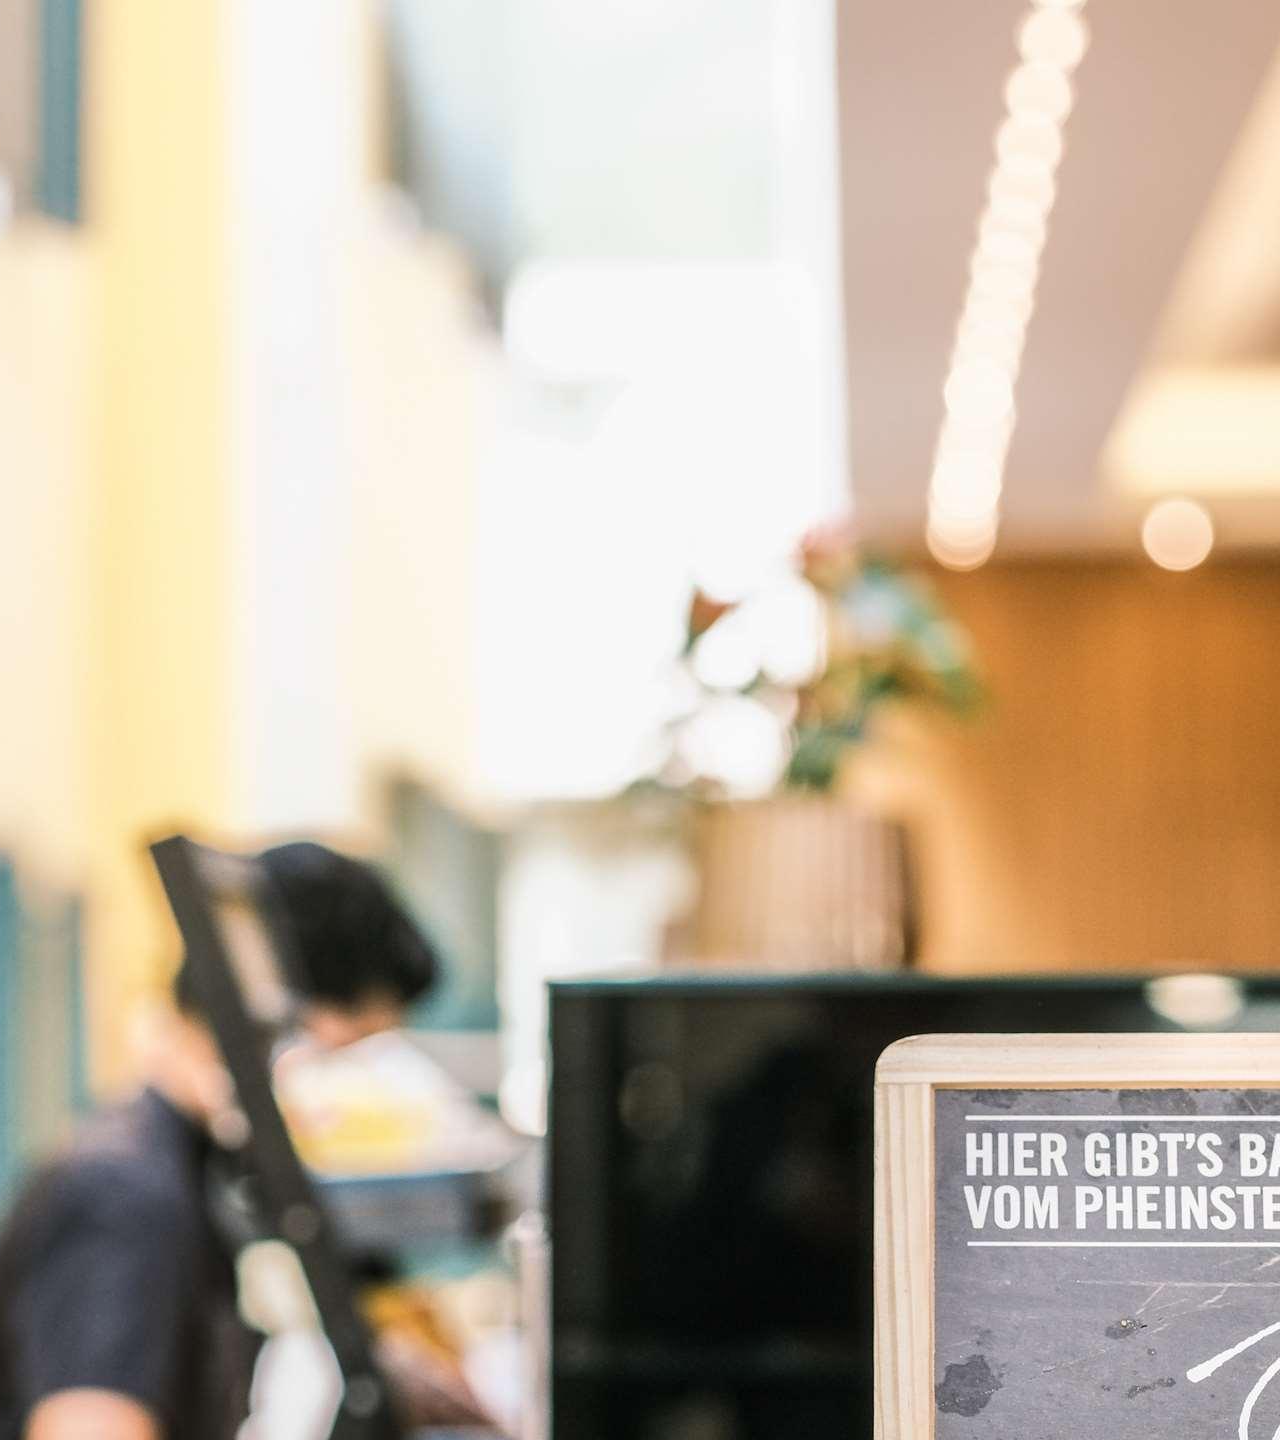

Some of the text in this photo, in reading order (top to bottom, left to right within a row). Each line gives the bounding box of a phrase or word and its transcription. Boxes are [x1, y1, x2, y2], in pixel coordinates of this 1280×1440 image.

[965, 1132, 1069, 1178] HIER
[1083, 1131, 1224, 1178] GIBT’S
[963, 1184, 1060, 1231] VOM
